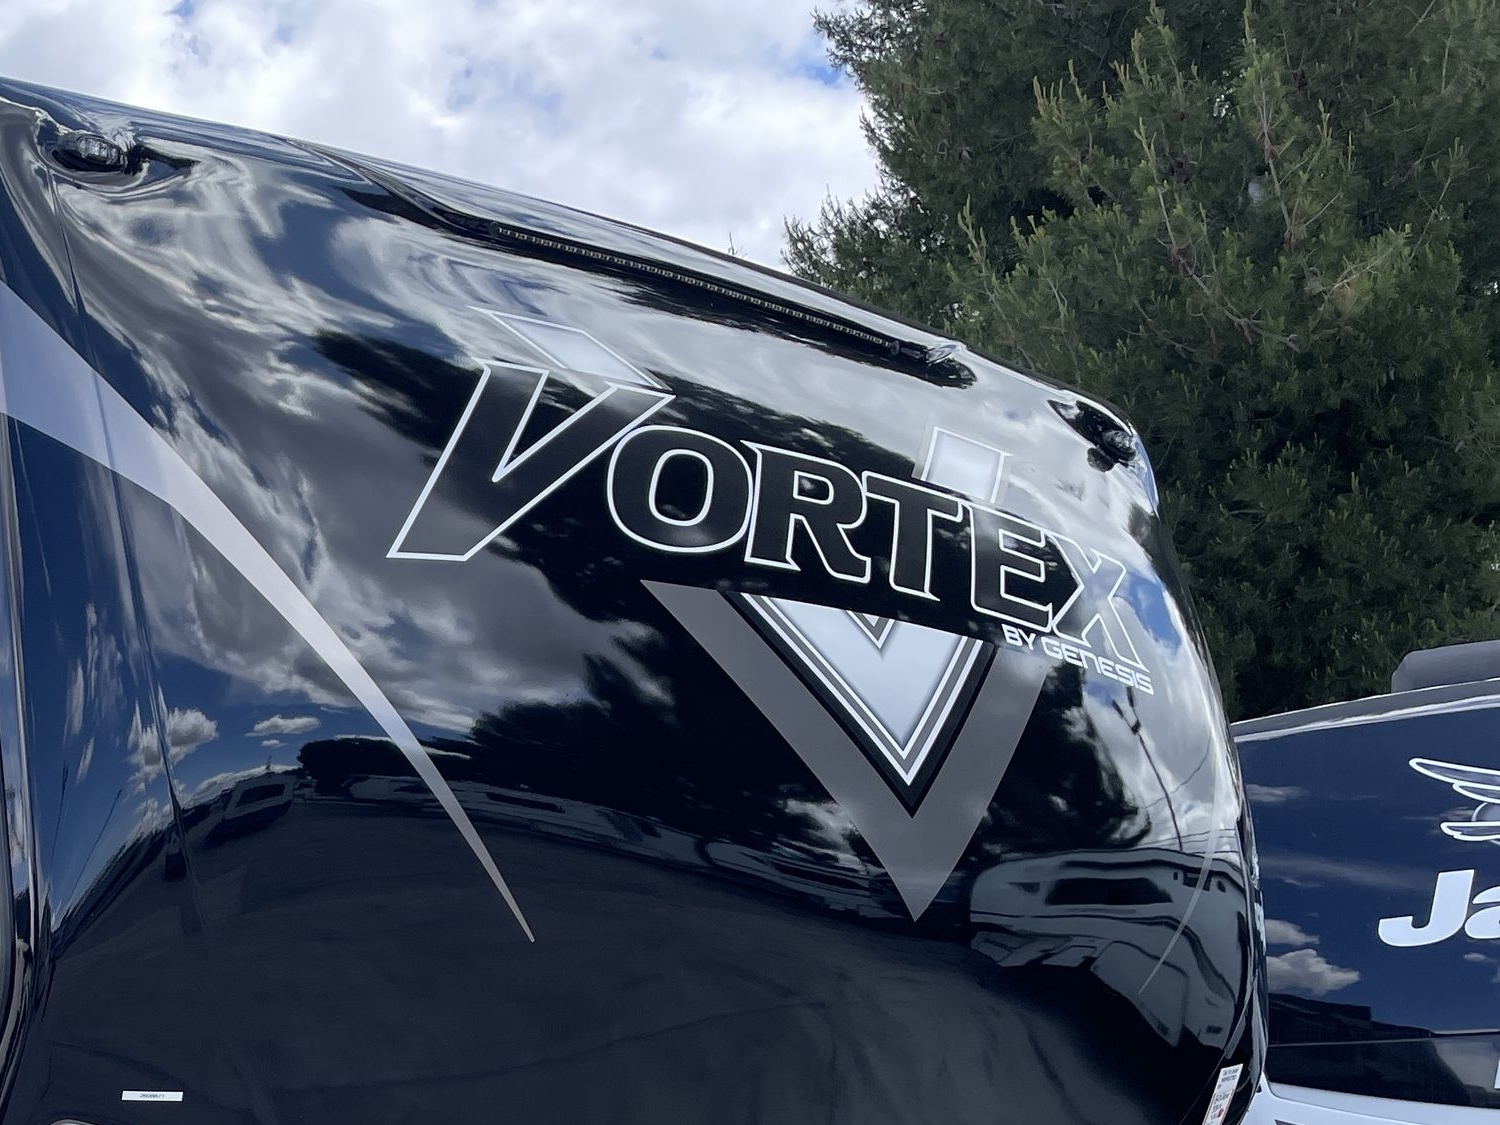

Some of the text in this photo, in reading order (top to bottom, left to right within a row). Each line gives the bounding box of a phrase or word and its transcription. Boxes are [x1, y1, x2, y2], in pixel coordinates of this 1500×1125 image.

[386, 359, 1150, 673] VORTEX
[1001, 623, 1155, 695] BY GENESIS
